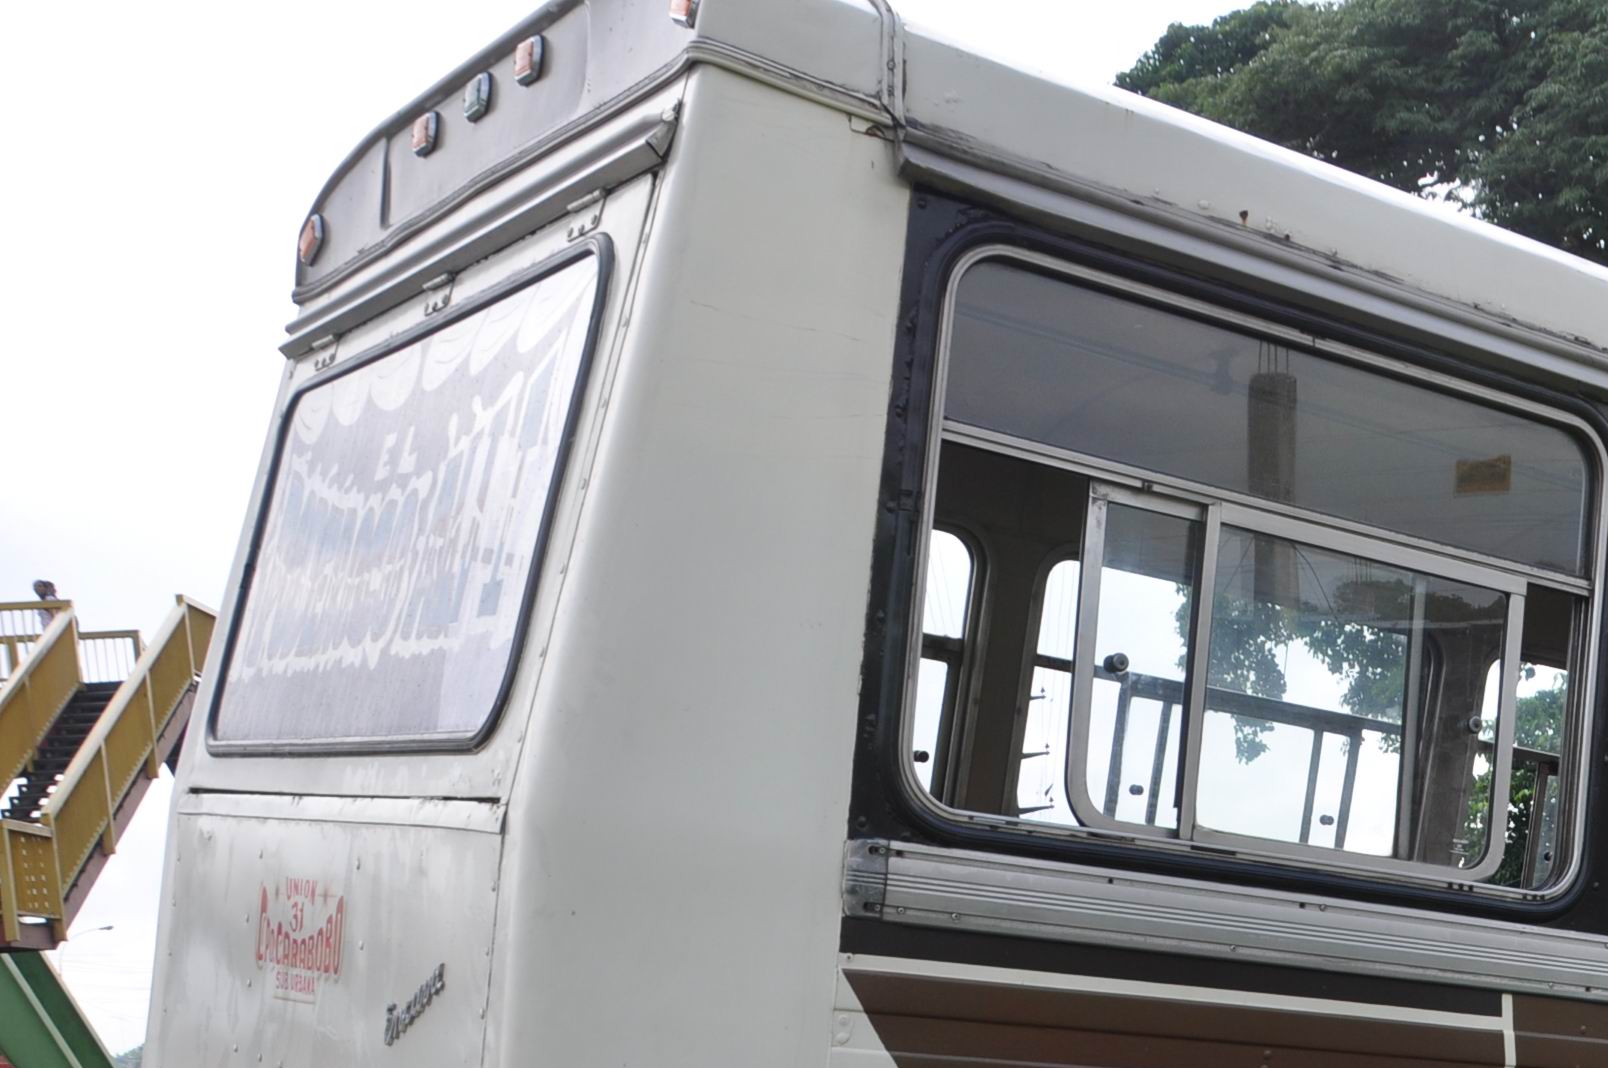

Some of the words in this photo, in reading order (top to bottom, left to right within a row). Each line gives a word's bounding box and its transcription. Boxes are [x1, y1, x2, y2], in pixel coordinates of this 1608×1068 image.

[374, 426, 418, 481] EL
[286, 877, 317, 905] UNION
[290, 902, 304, 932] 31
